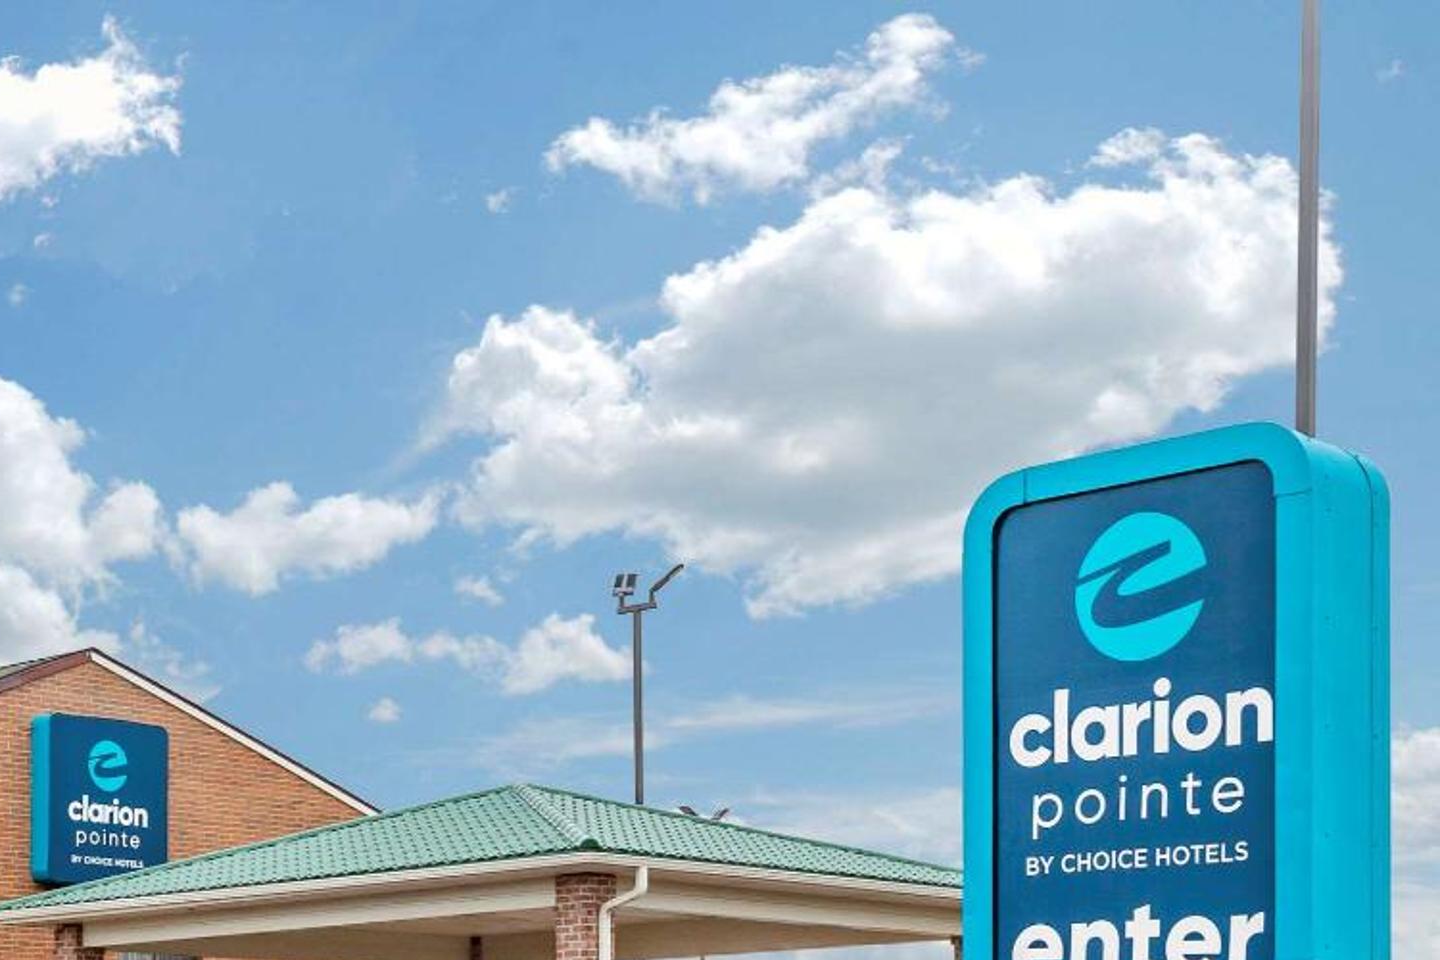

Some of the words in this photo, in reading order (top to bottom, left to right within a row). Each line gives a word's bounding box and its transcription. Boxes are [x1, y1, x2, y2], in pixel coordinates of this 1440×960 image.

[1009, 677, 1274, 768] clarion
[67, 794, 149, 828] clarion
[1032, 772, 1245, 840] pointe
[75, 828, 141, 849] pointe
[1026, 856, 1055, 876] BY
[1061, 848, 1148, 873] CHOICE
[1155, 841, 1249, 866] HOTELS
